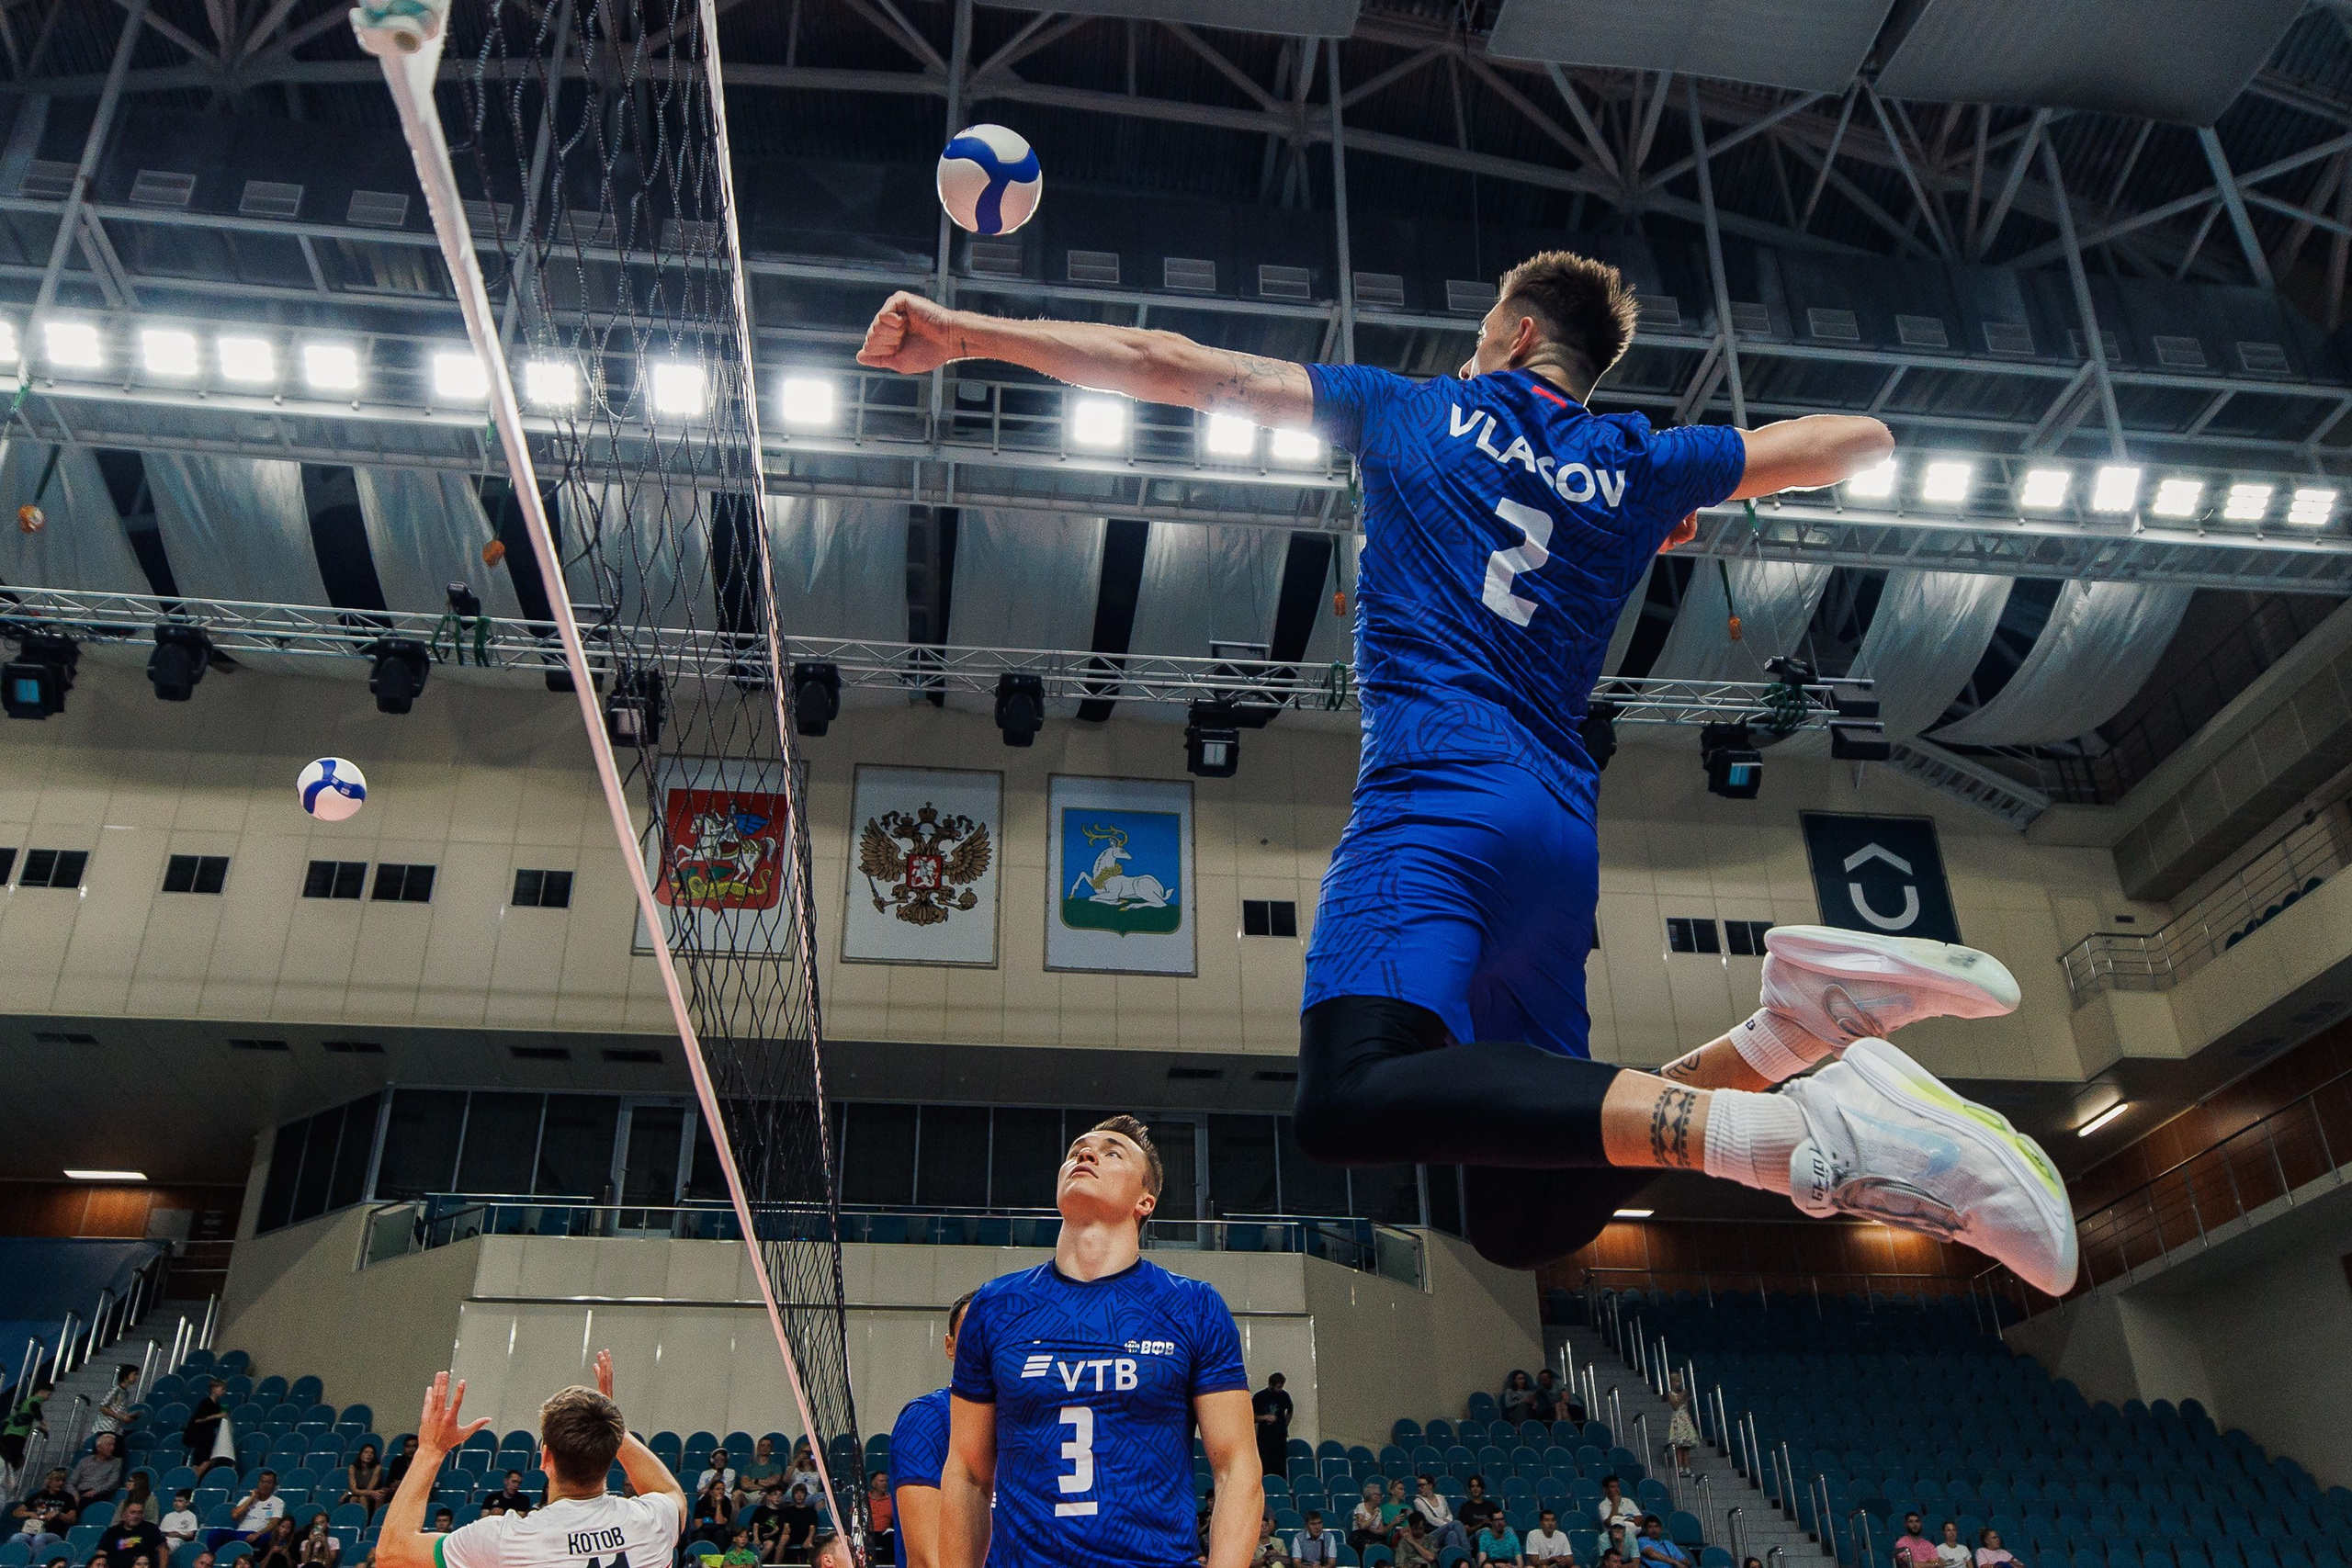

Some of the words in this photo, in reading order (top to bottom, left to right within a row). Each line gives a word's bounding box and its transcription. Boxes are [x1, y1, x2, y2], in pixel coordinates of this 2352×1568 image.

[1449, 402, 1626, 507] VLASOV
[1481, 497, 1554, 627] 2
[1057, 1359, 1138, 1392] VTB
[1058, 1406, 1093, 1494] 3
[568, 1526, 626, 1555] КОТОВ
